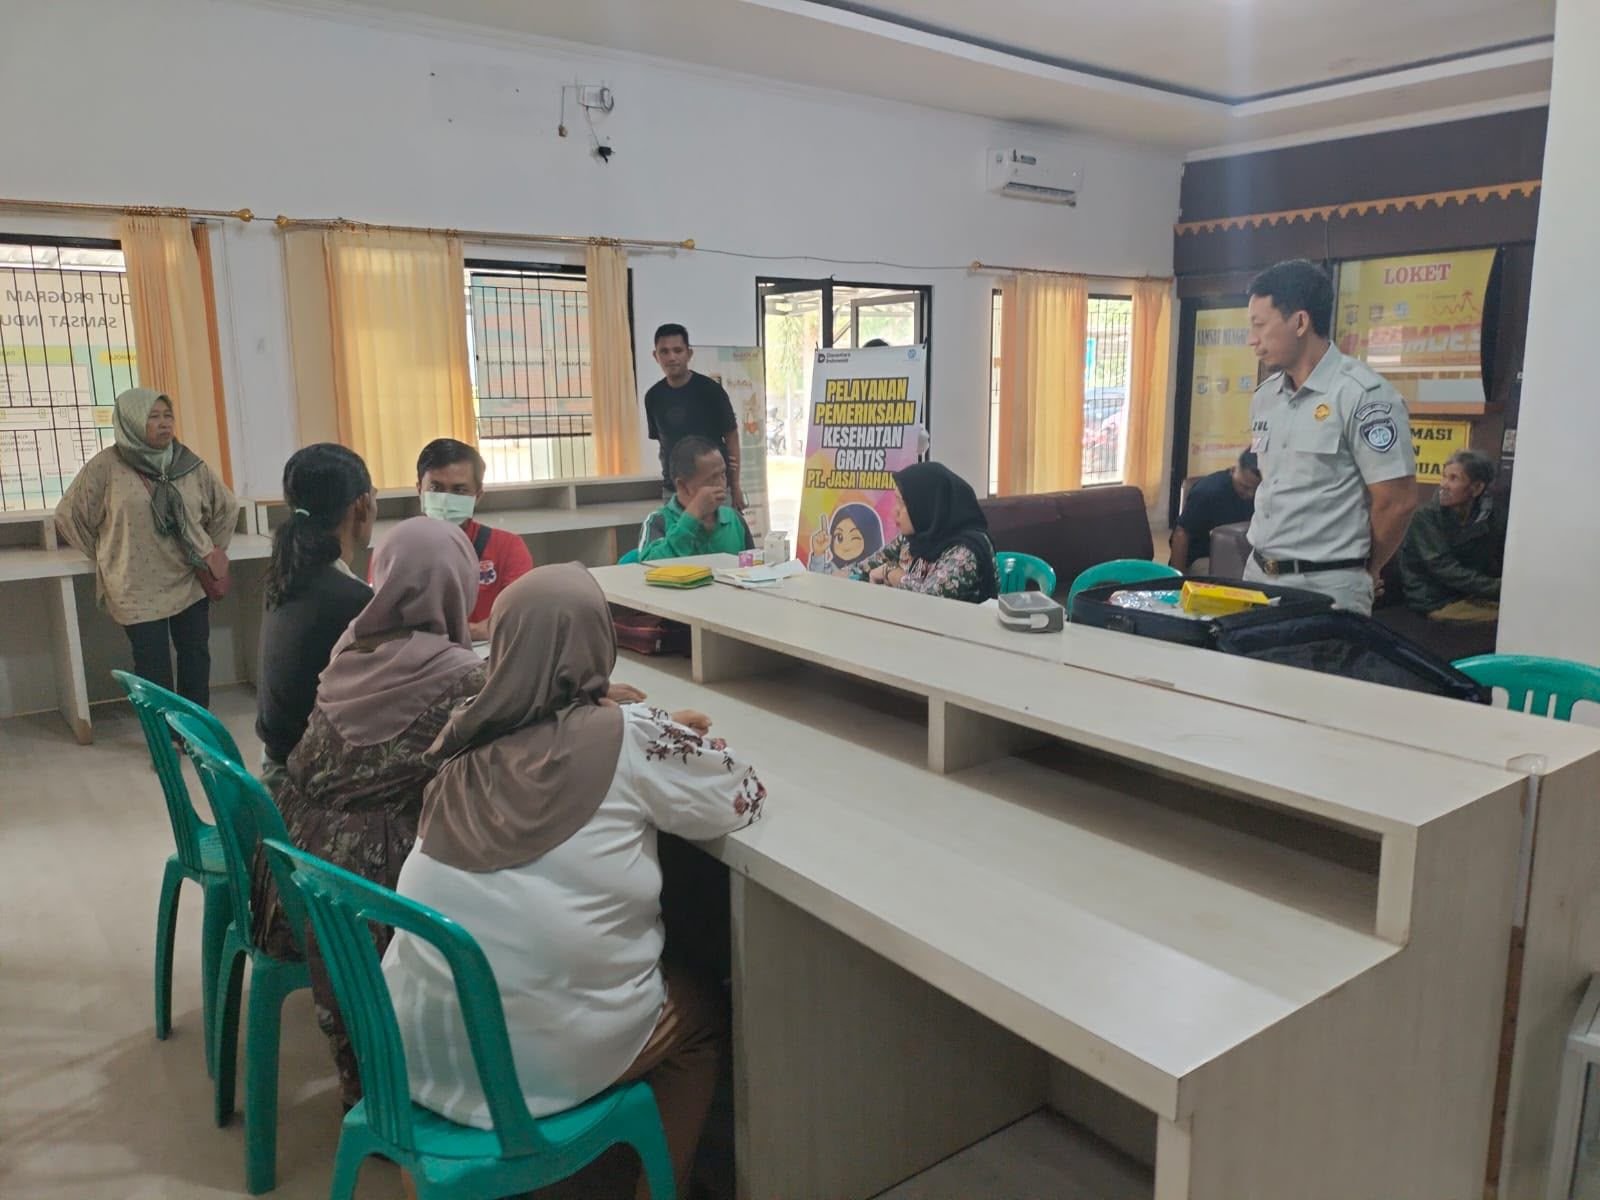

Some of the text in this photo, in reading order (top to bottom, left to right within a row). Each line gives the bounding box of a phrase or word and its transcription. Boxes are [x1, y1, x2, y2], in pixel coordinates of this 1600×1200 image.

[1383, 263, 1452, 285] LOKET
[827, 378, 908, 402] PELAYANAN
[814, 401, 916, 426] PEMERIKSAAN
[822, 425, 904, 448] KESEHATAN
[836, 449, 886, 471] GRATIS
[806, 469, 826, 488] PT.
[827, 470, 857, 488] JASA
